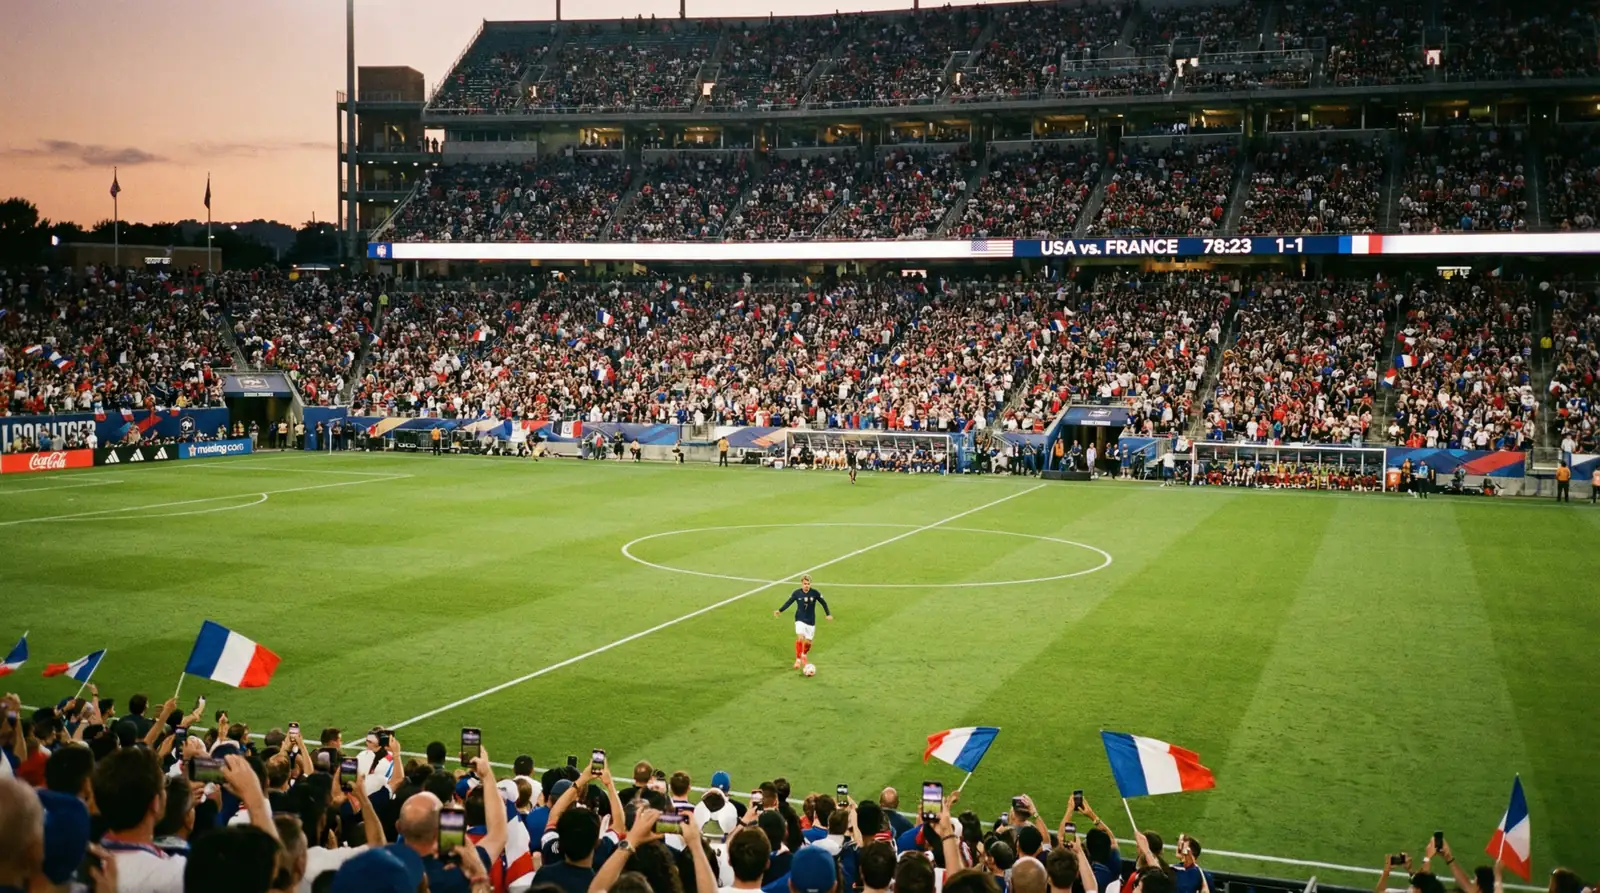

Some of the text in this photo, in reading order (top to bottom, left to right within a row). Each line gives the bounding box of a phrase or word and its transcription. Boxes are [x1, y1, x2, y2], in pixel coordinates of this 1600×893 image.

[1041, 237, 1303, 256] USA vs. FRANCE 78:23 1-1
